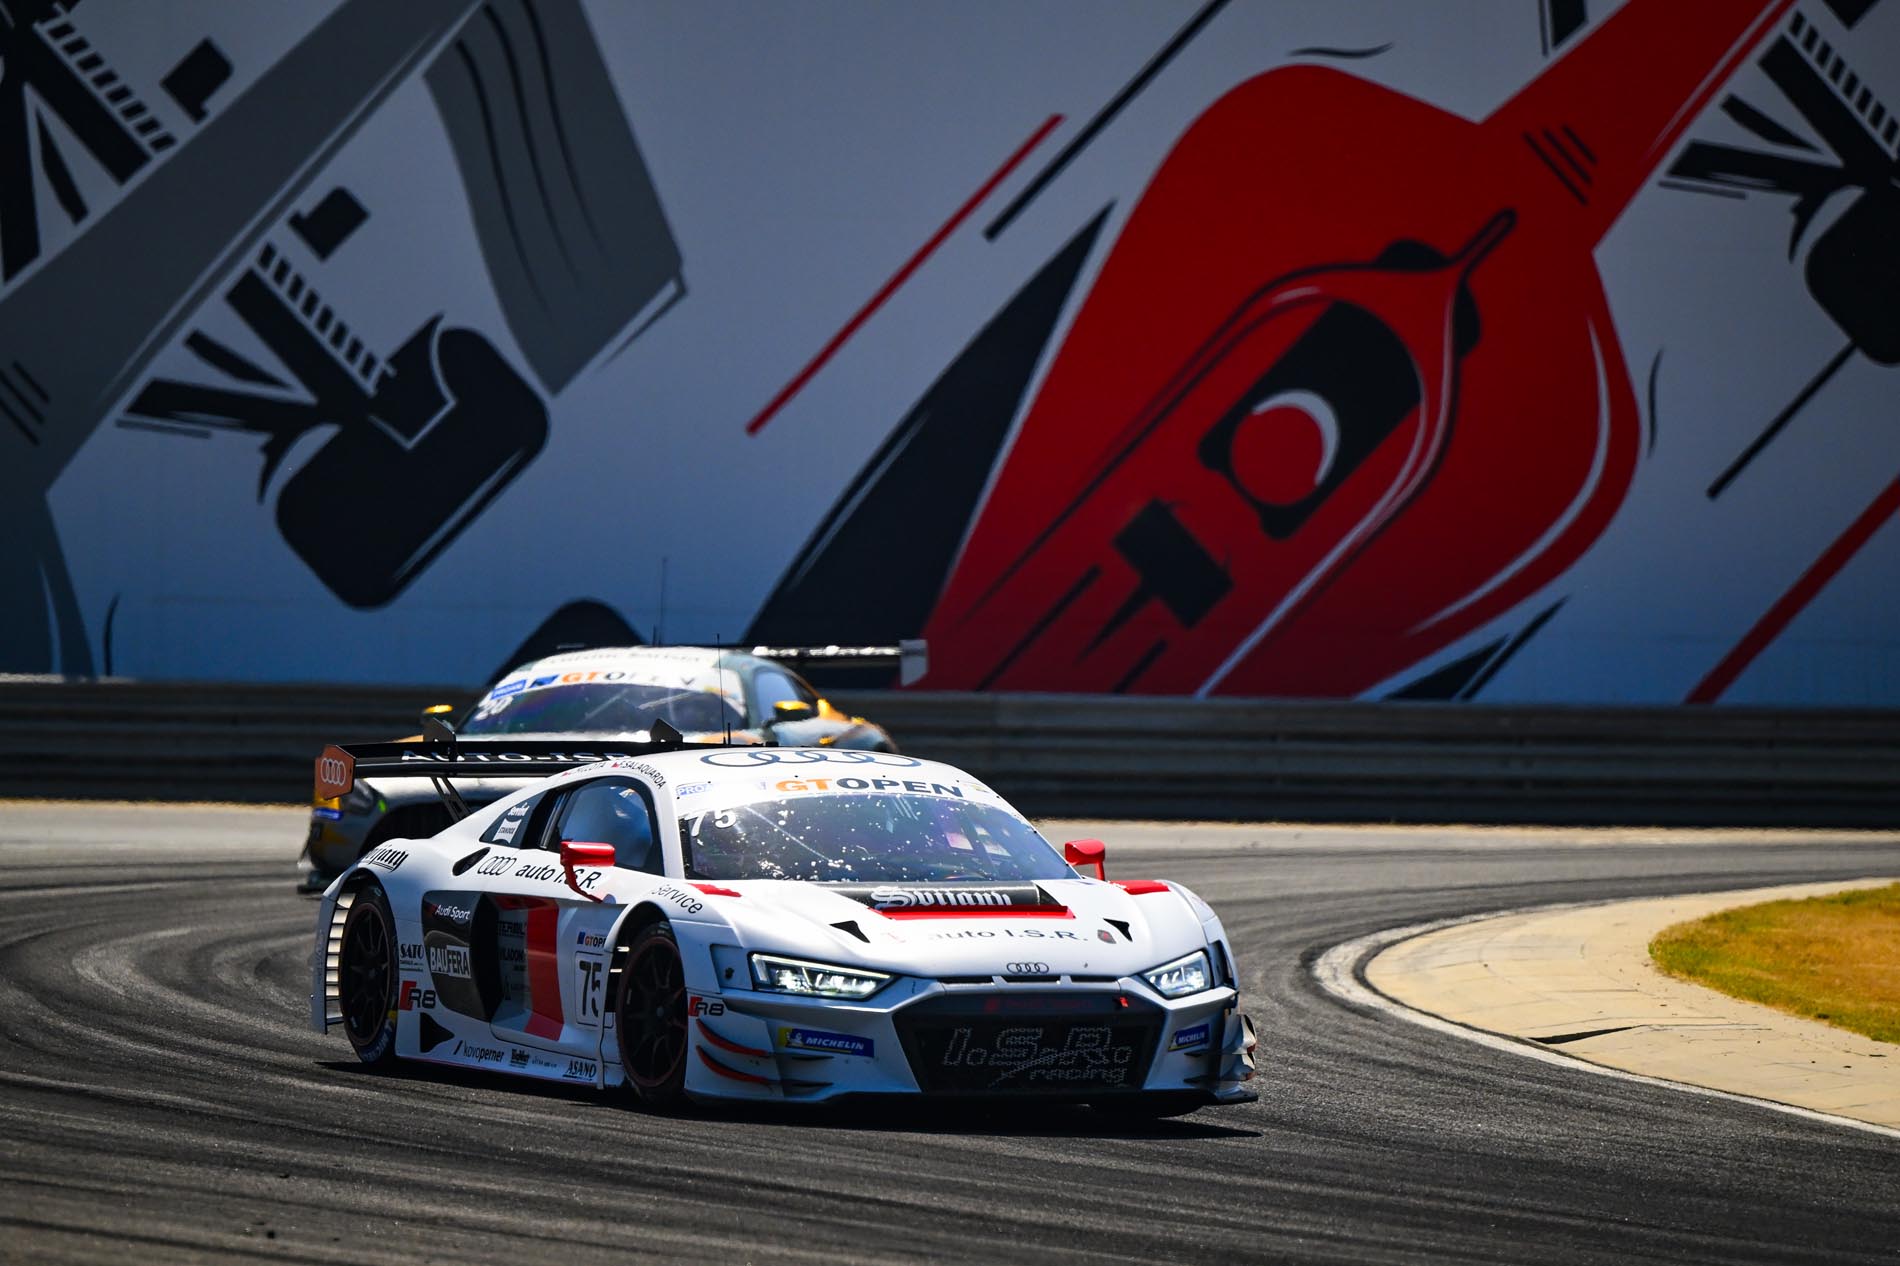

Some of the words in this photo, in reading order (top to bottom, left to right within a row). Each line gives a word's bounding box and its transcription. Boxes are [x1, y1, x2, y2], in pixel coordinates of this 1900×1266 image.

[683, 809, 737, 837] 75
[515, 863, 556, 882] auto
[435, 904, 453, 918] Audi
[452, 906, 471, 920] Sport
[1004, 928, 1089, 942] I.S.R.
[431, 945, 471, 976] BAUFERA
[579, 960, 603, 1018] 75
[806, 1037, 865, 1051] MICHELIN
